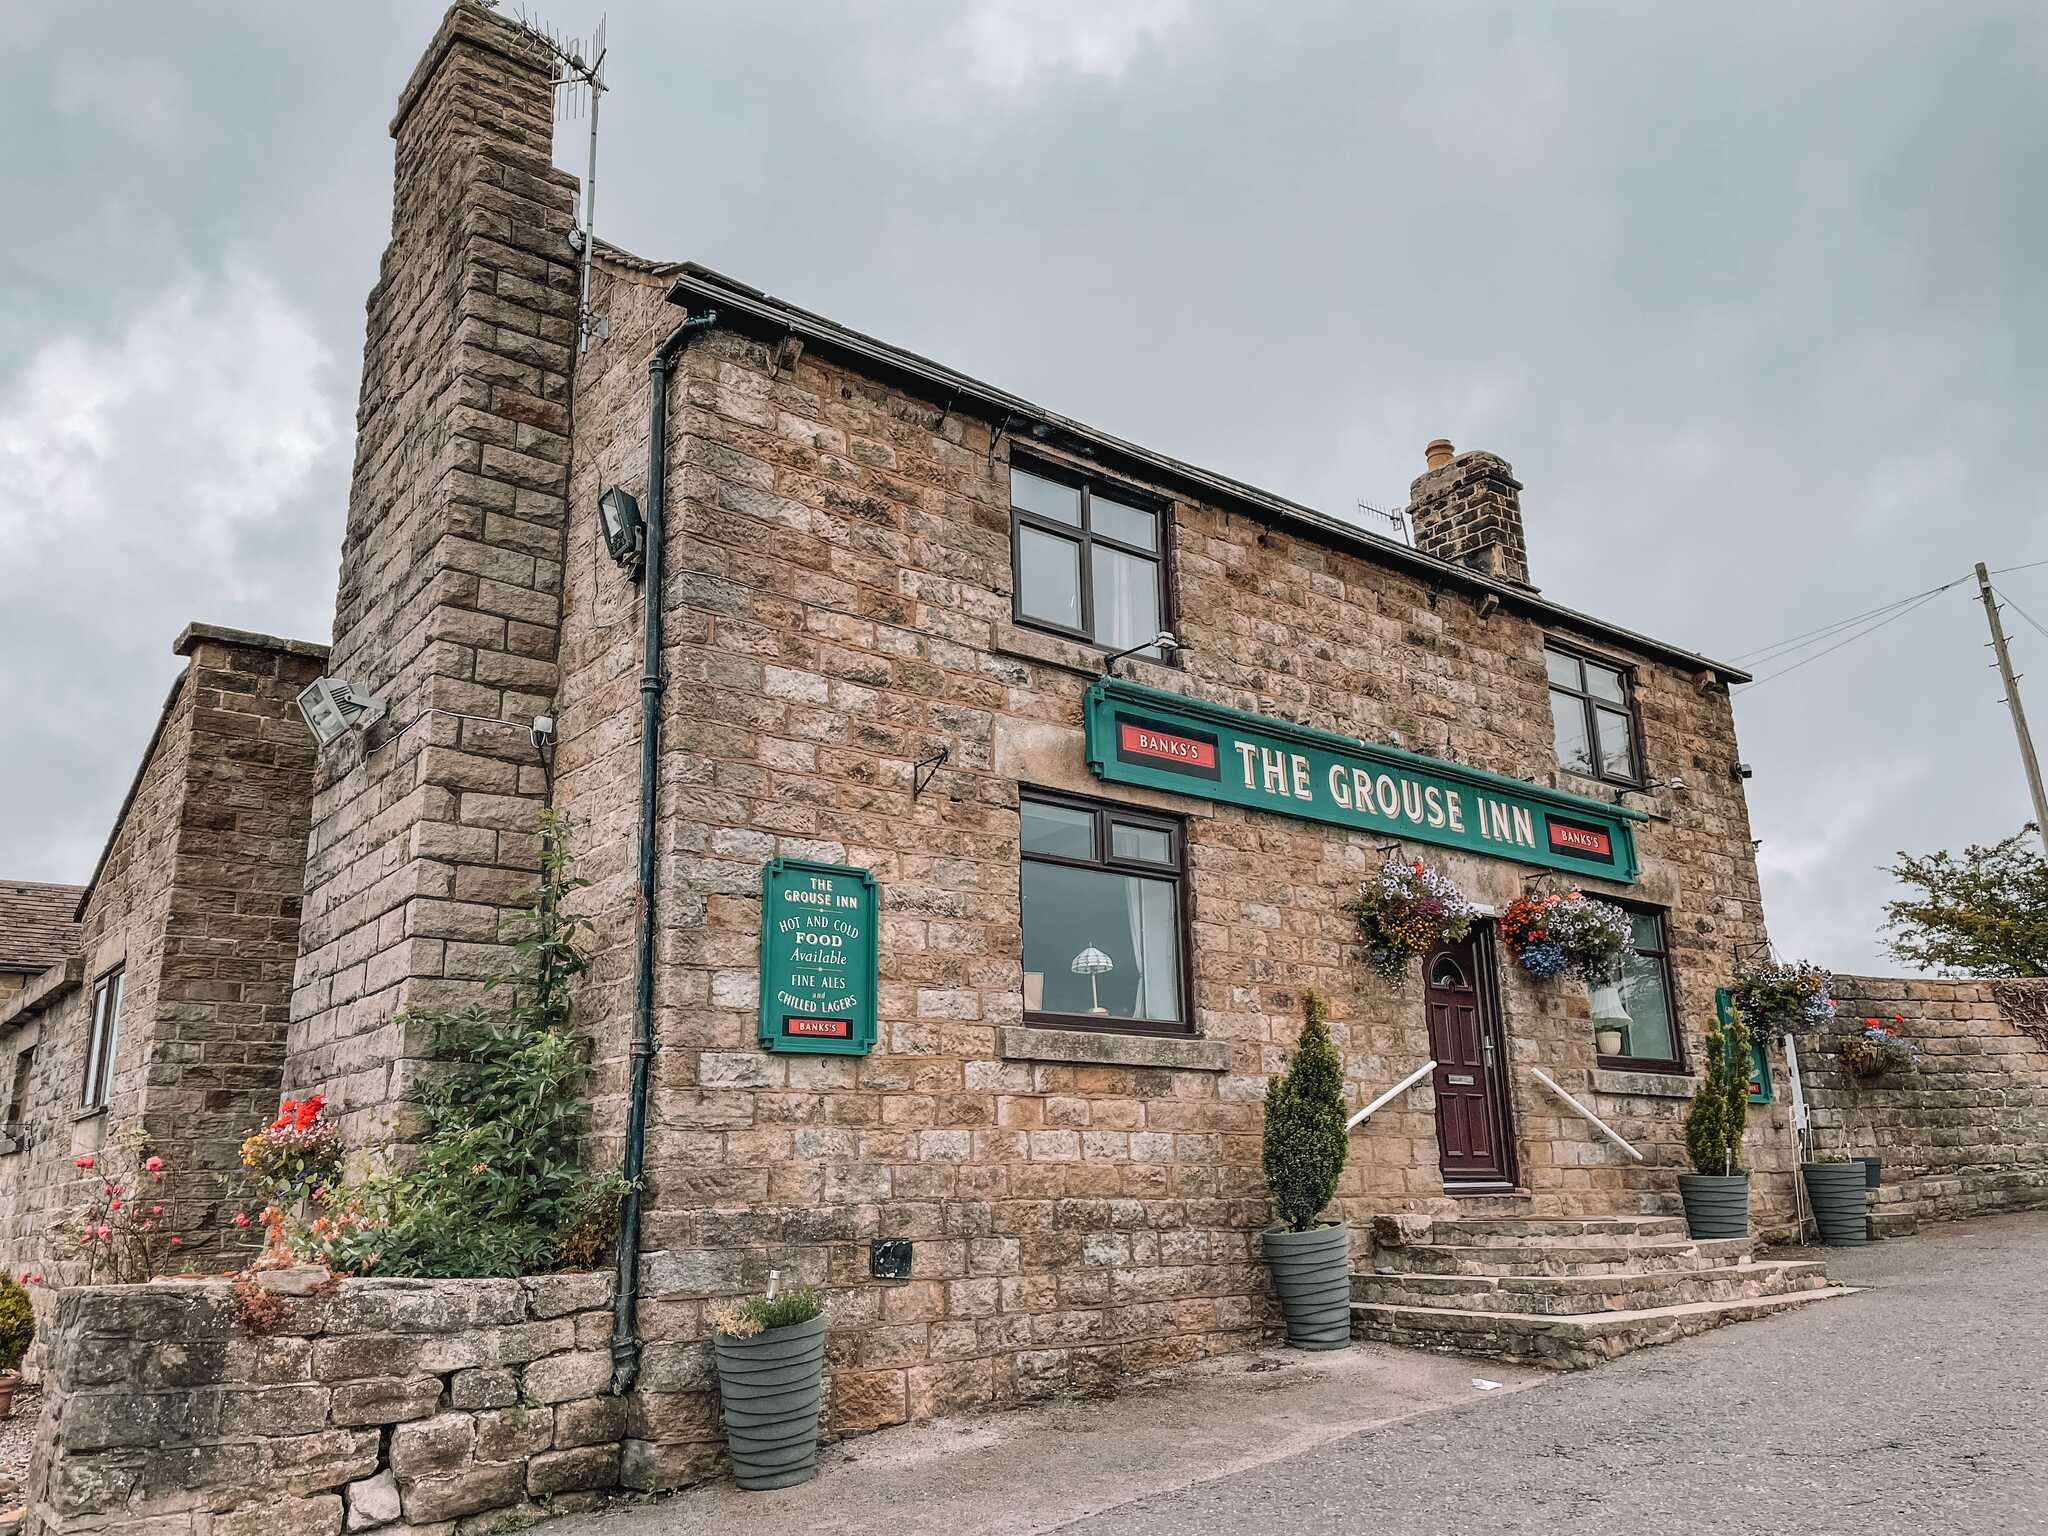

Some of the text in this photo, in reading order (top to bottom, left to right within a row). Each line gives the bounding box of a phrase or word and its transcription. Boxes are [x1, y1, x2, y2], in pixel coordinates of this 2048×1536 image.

[1139, 734, 1199, 759] BANKS'S
[1234, 740, 1536, 849] THE GROUSE INN
[1561, 829, 1599, 849] BANKS'S
[810, 877, 833, 891] THE
[784, 890, 858, 909] GROUSE INN
[778, 915, 859, 939] HOT AND COLD
[795, 931, 843, 948] FOOD
[790, 948, 848, 965] Available
[791, 974, 846, 989] FINE ALES
[777, 990, 858, 1013] CHILLED LAGERS
[812, 990, 826, 1000] and
[799, 1022, 837, 1033] BANKS'S
